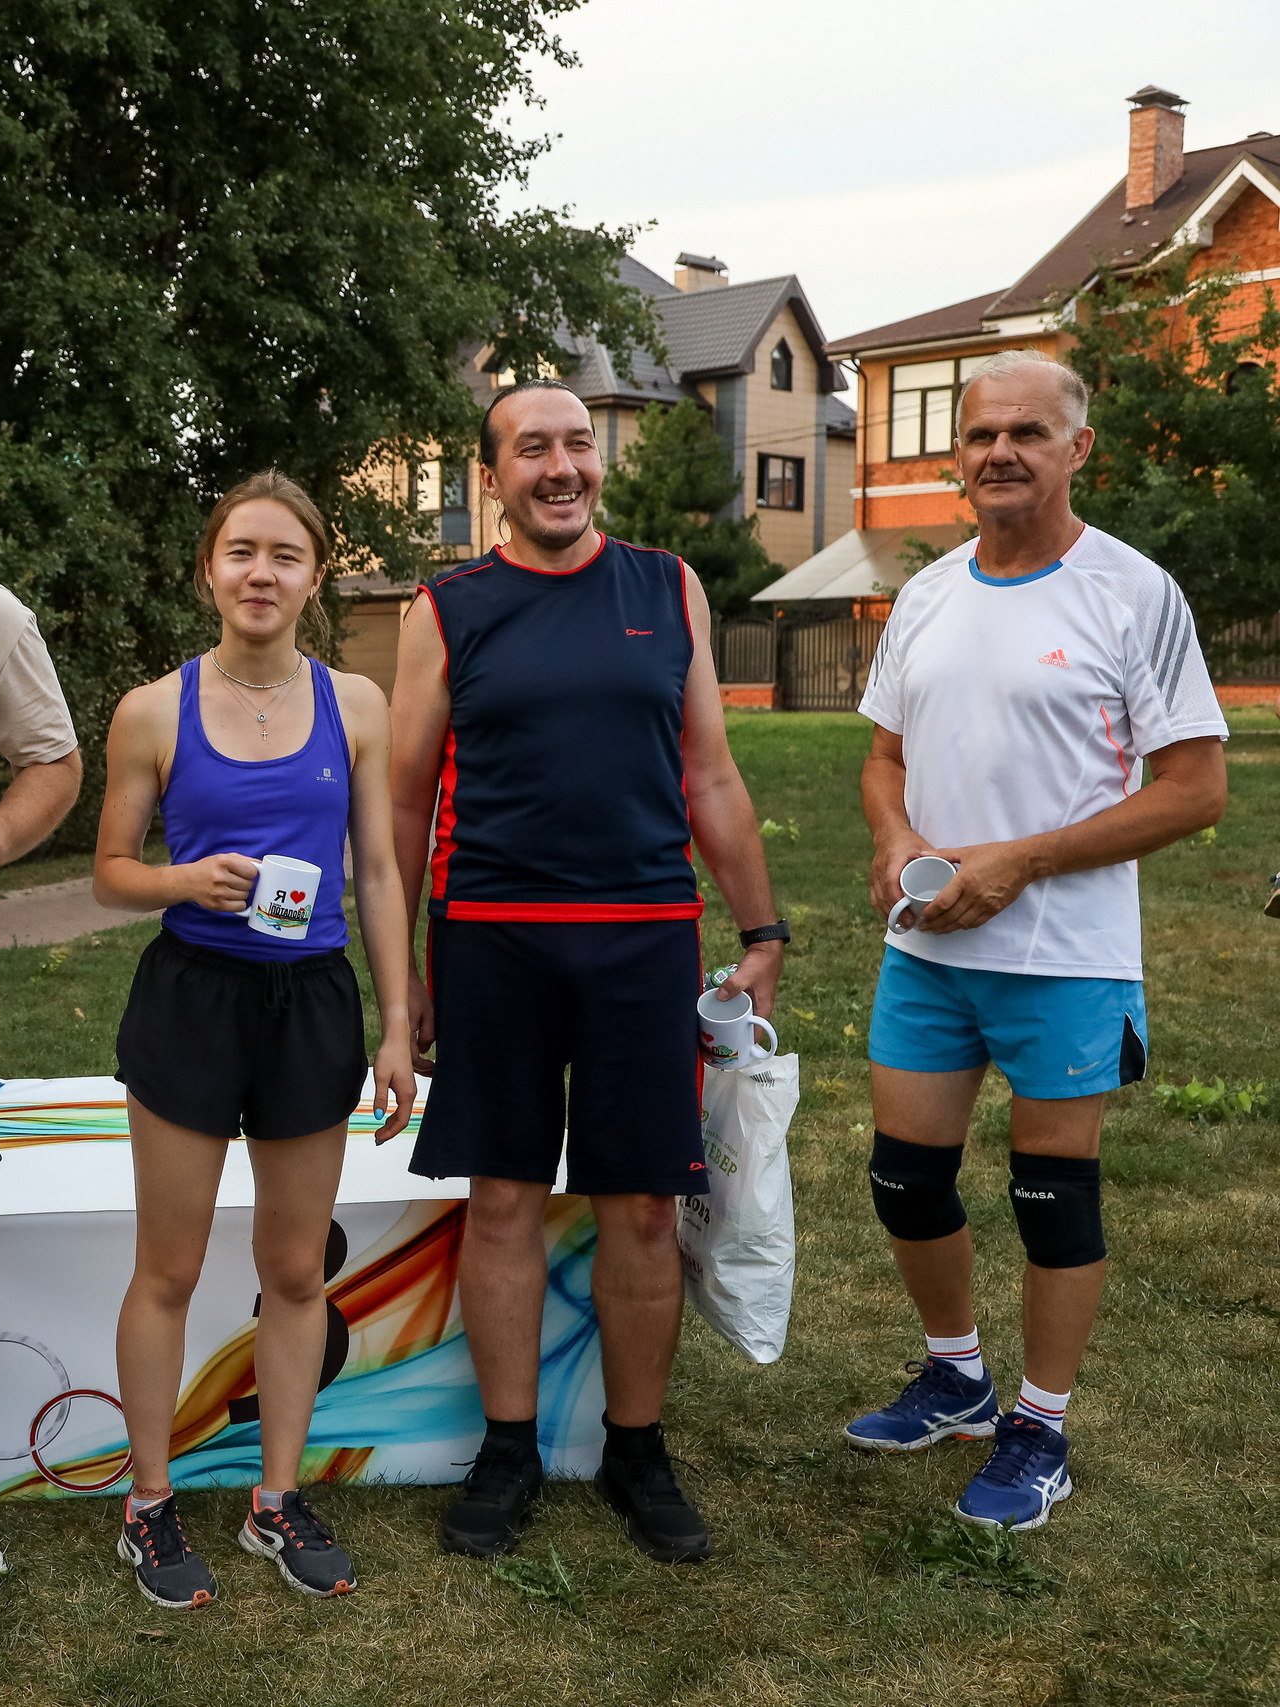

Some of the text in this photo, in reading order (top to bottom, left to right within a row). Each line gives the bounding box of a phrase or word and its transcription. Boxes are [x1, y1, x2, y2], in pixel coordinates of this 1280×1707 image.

[1038, 657, 1070, 669] adidas
[274, 889, 287, 904] Я
[702, 1140, 738, 1177] ЕВЕР
